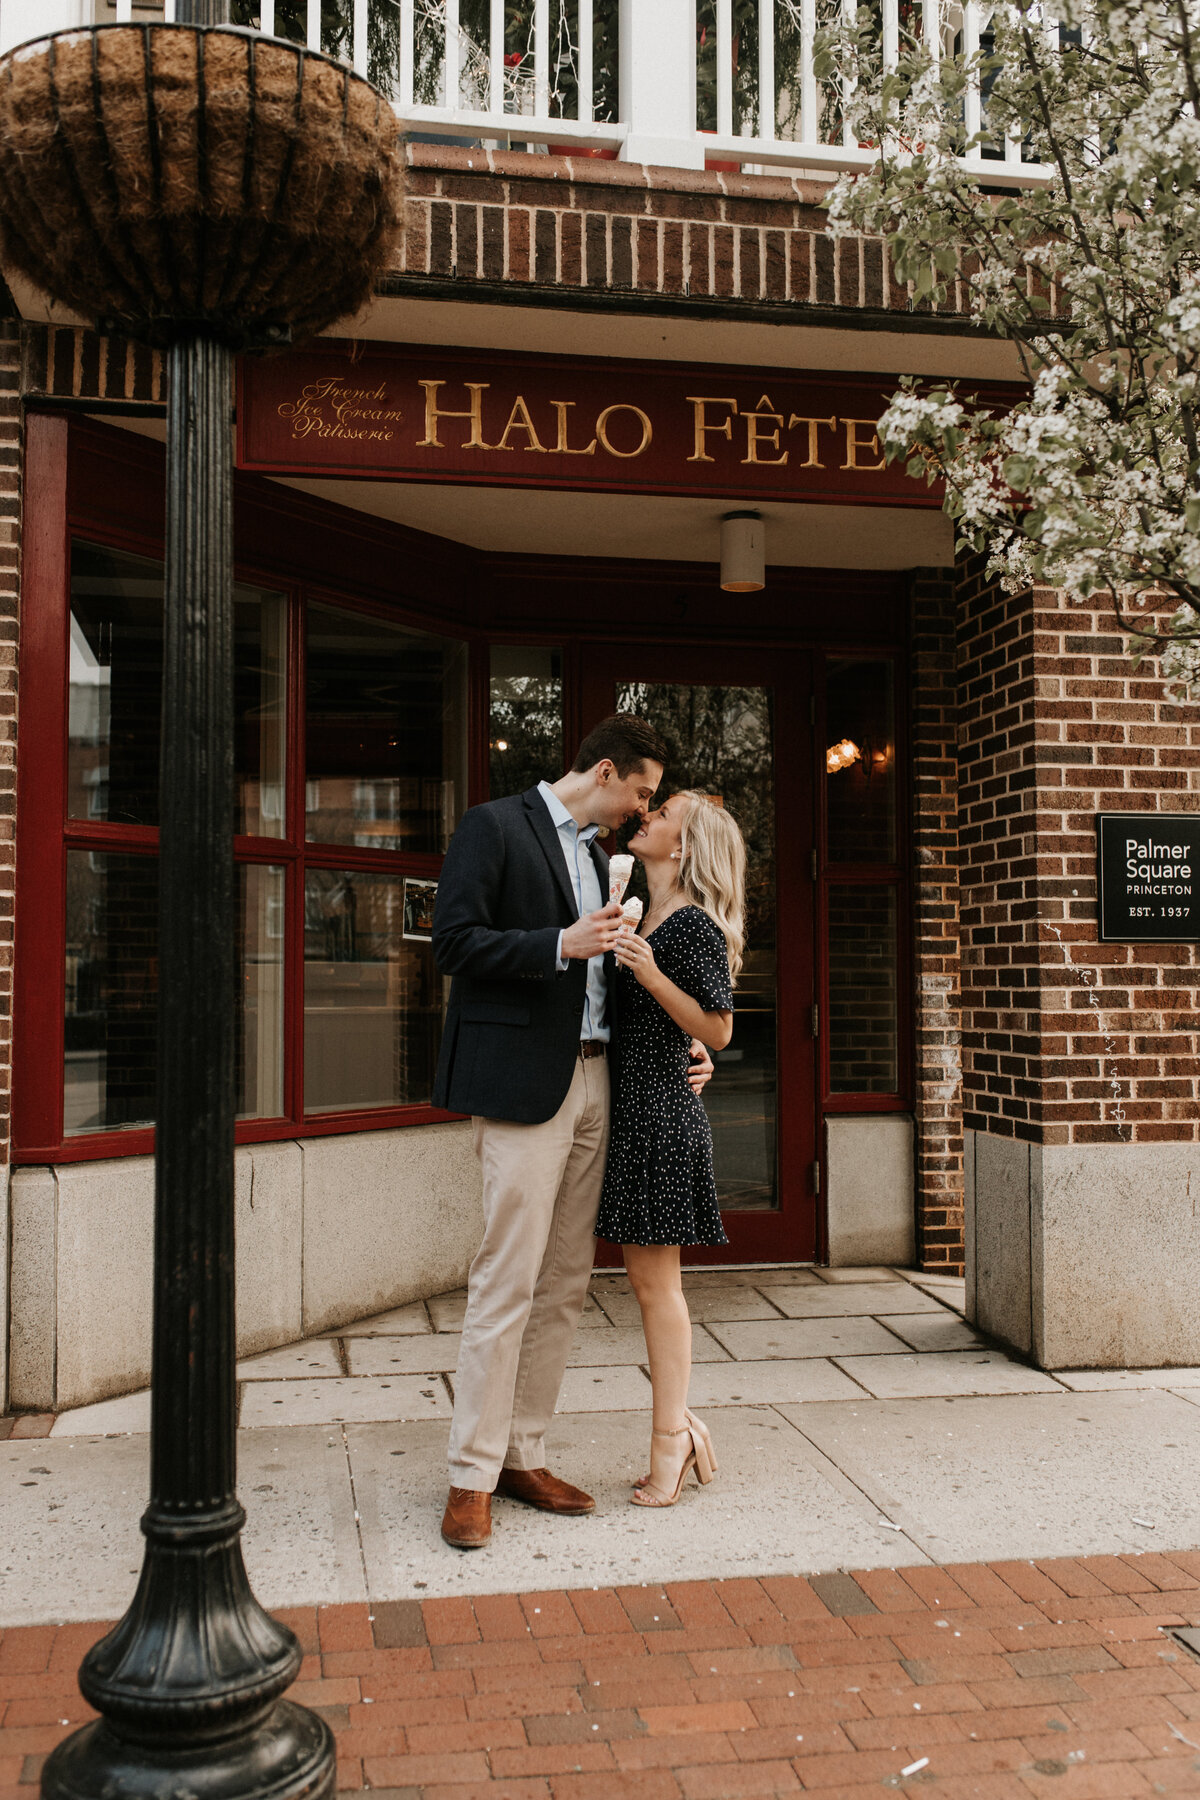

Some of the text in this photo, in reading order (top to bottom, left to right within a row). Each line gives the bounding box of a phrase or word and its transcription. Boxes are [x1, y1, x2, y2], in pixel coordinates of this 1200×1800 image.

[302, 377, 386, 400] French
[277, 397, 404, 424] Ice Cream
[292, 414, 394, 441] Pâtisserie
[416, 380, 653, 459] HALO
[685, 394, 887, 472] FÊTE
[1125, 838, 1191, 859] Palmer
[1126, 859, 1192, 884] Square
[1126, 885, 1192, 895] PRINCETON
[1128, 907, 1190, 917] EST. 1937
